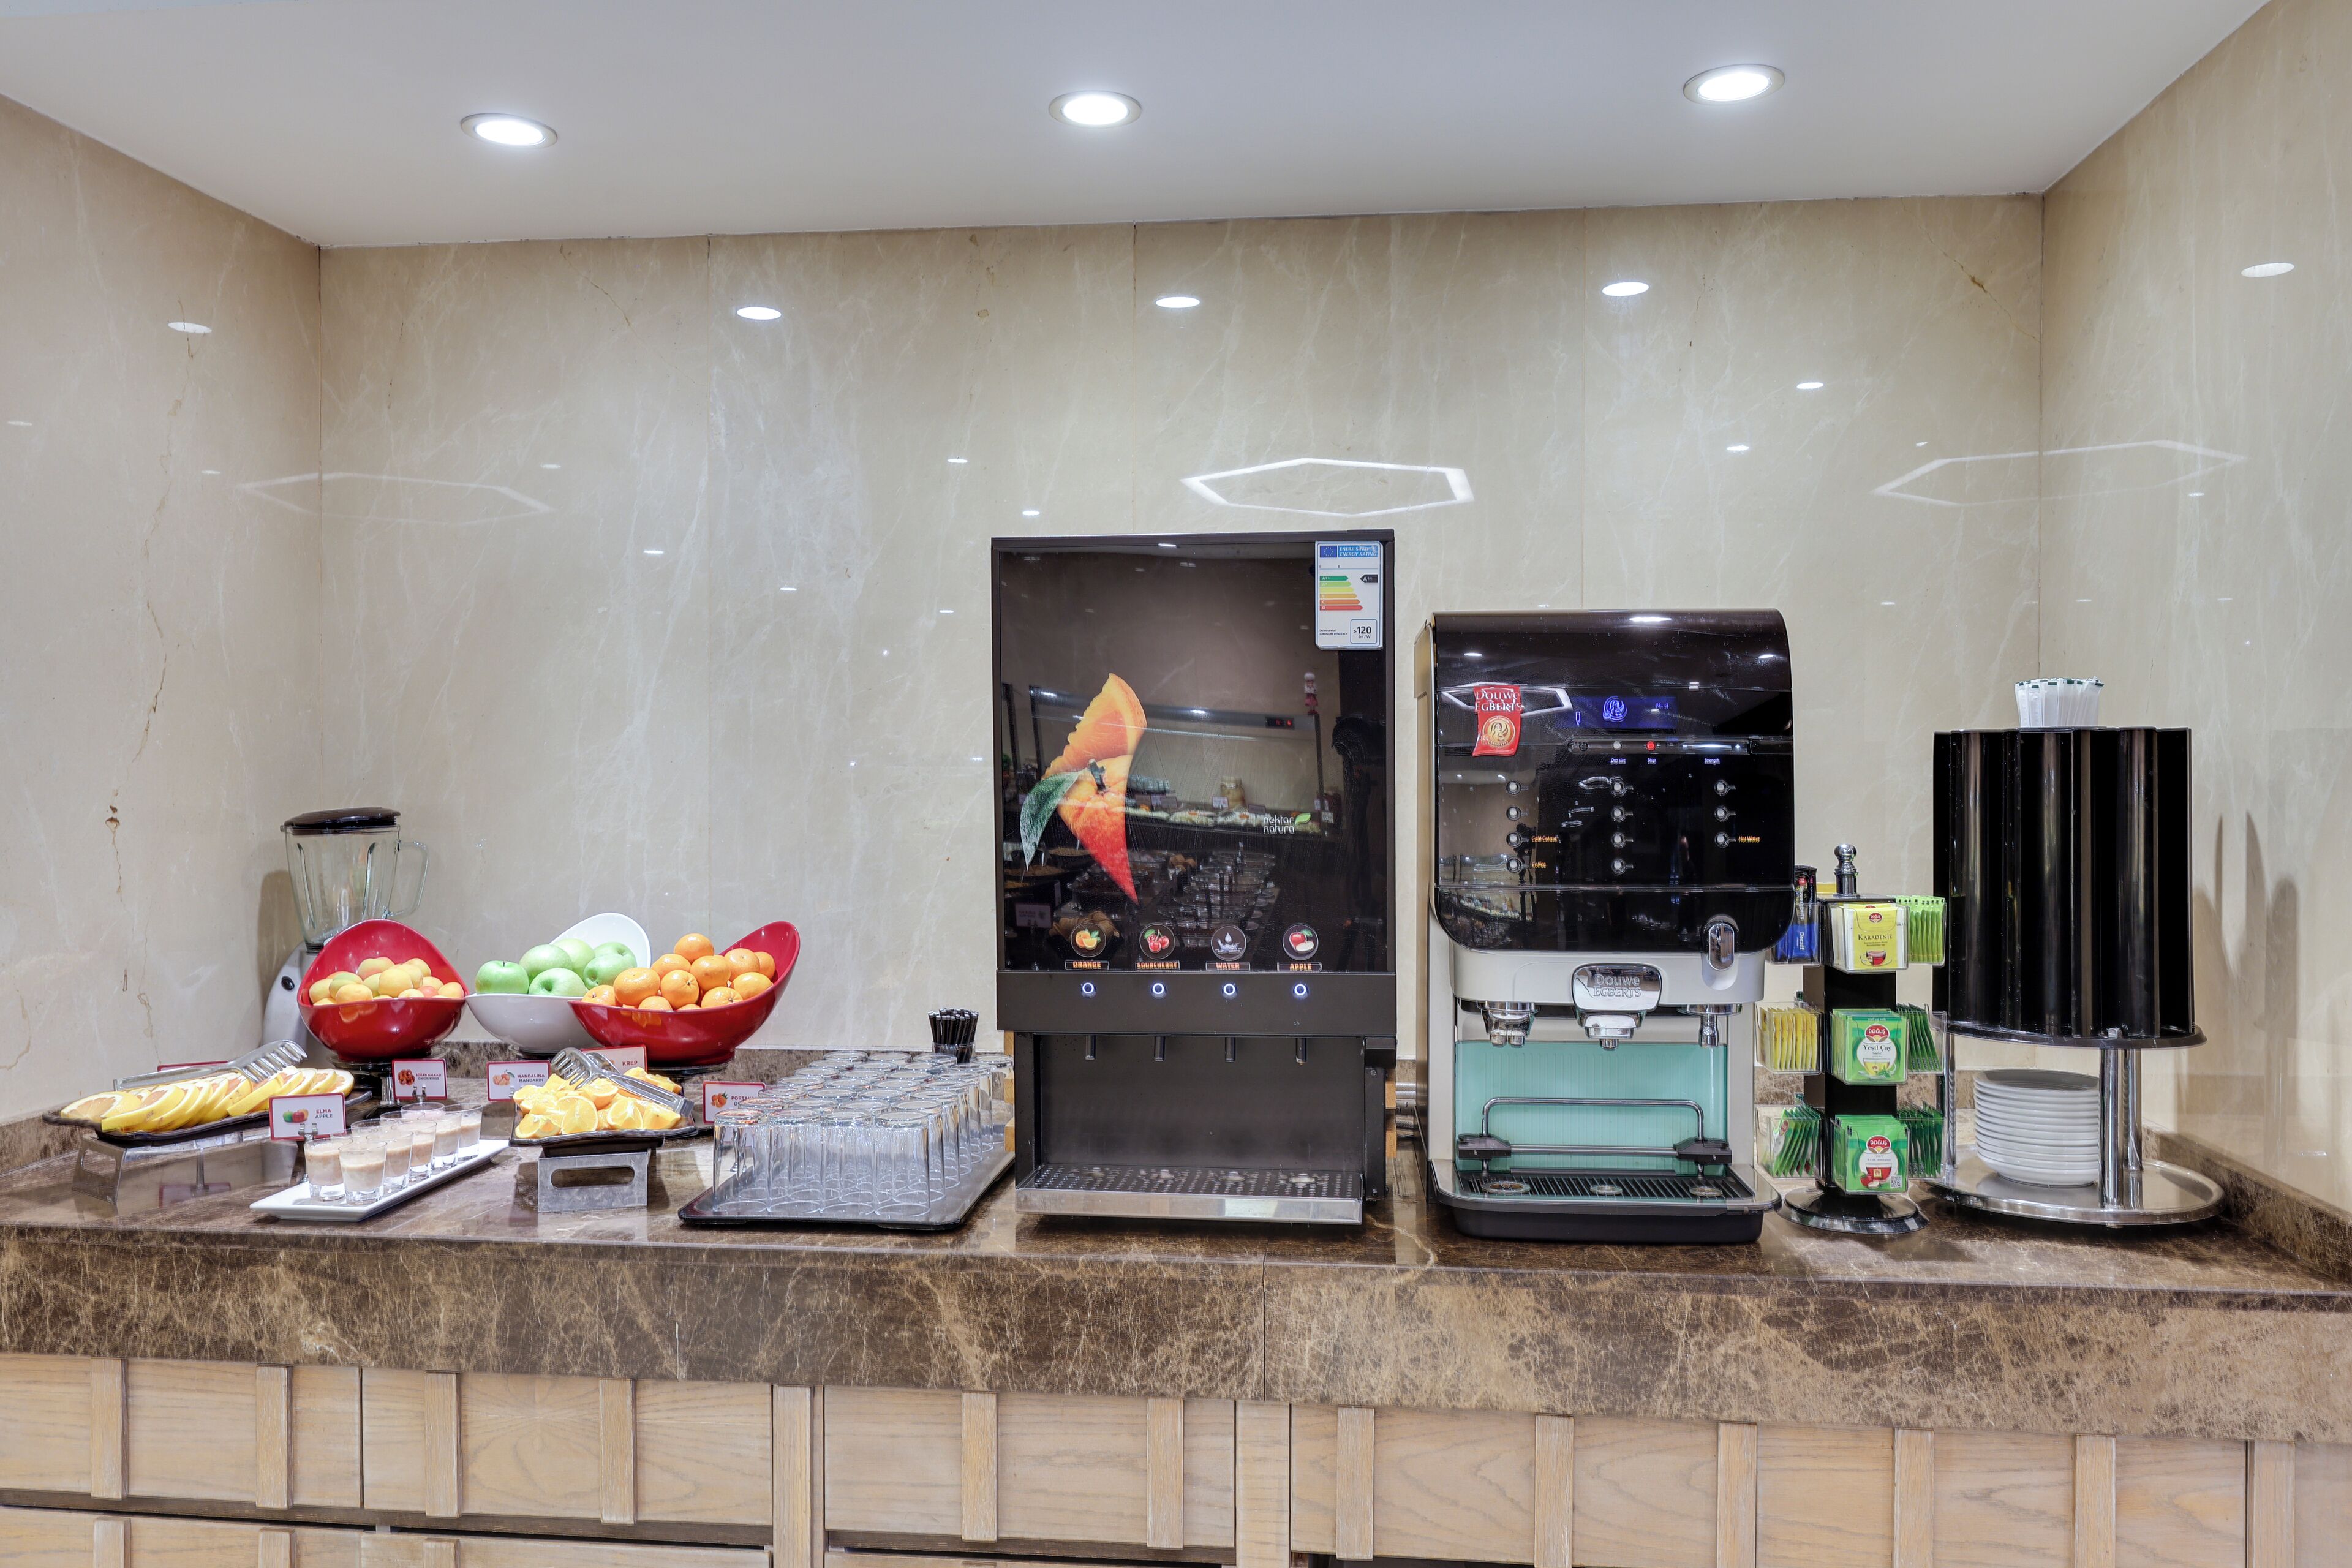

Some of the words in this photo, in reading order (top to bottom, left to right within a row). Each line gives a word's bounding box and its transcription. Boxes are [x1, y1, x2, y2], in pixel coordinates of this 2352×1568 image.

[1263, 815, 1294, 824] nektar
[1263, 824, 1295, 834] natura
[1593, 986, 1642, 998] EGBERTS
